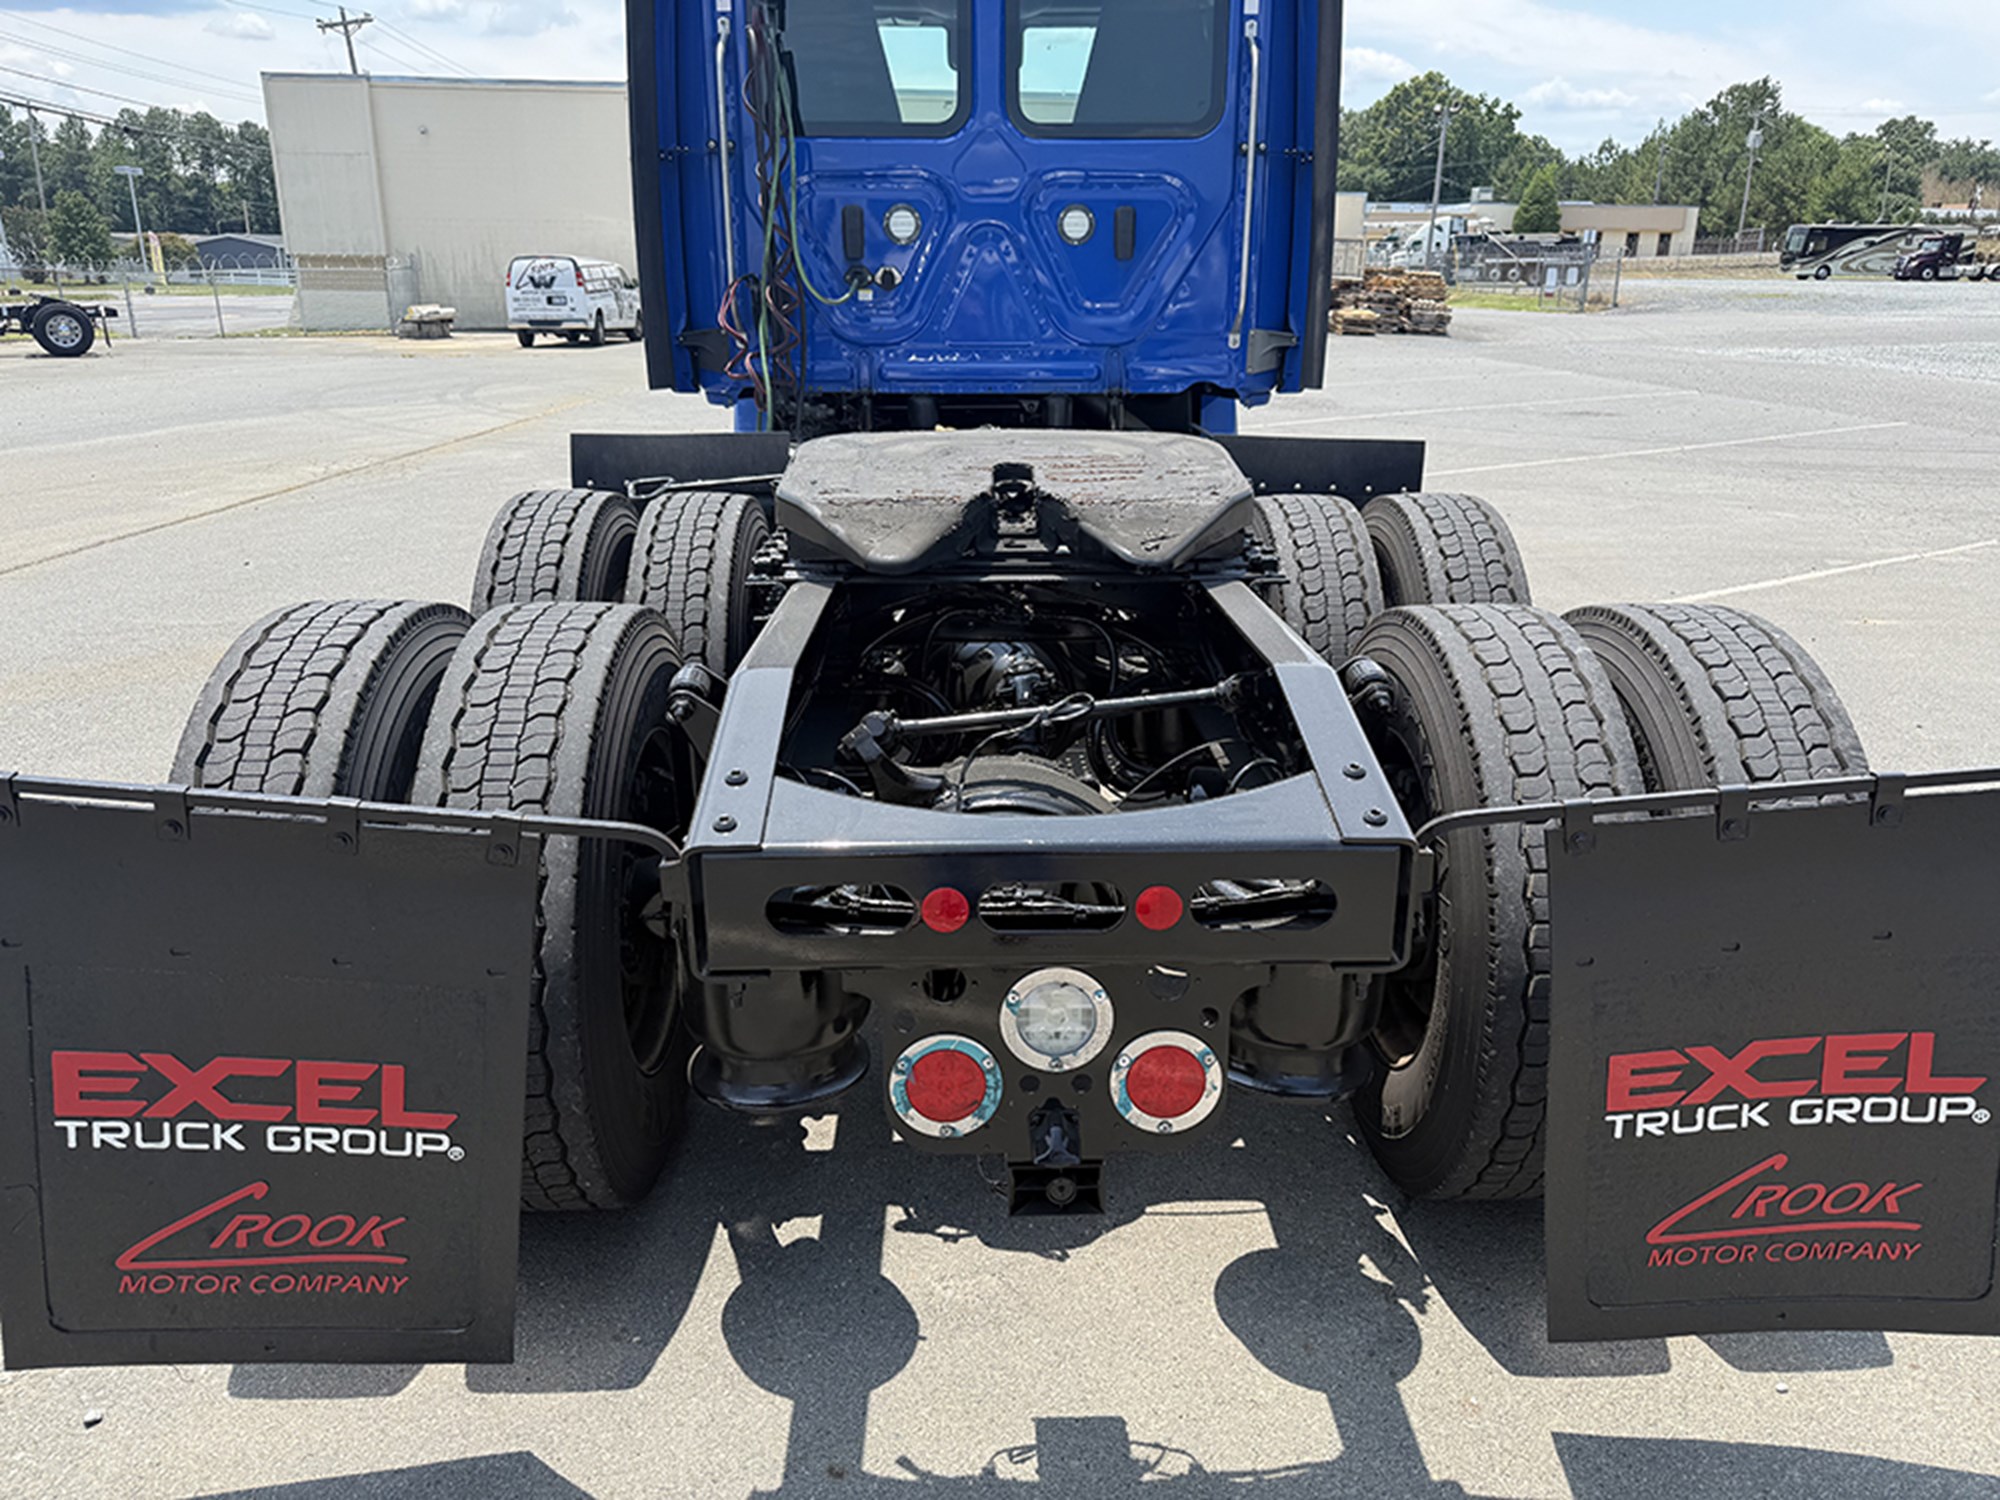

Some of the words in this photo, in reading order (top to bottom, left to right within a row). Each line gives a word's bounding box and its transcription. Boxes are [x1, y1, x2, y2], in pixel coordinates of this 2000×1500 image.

[1605, 1031, 1988, 1112] EXCEL
[51, 1051, 458, 1130] EXCEL
[53, 1120, 246, 1151] TRUCK
[1604, 1101, 1770, 1139] TRUCK
[1647, 1245, 1759, 1267] MOTOR
[1765, 1242, 1921, 1263] COMPANY
[119, 1275, 241, 1294] MOTOR
[249, 1275, 409, 1294] COMPANY
